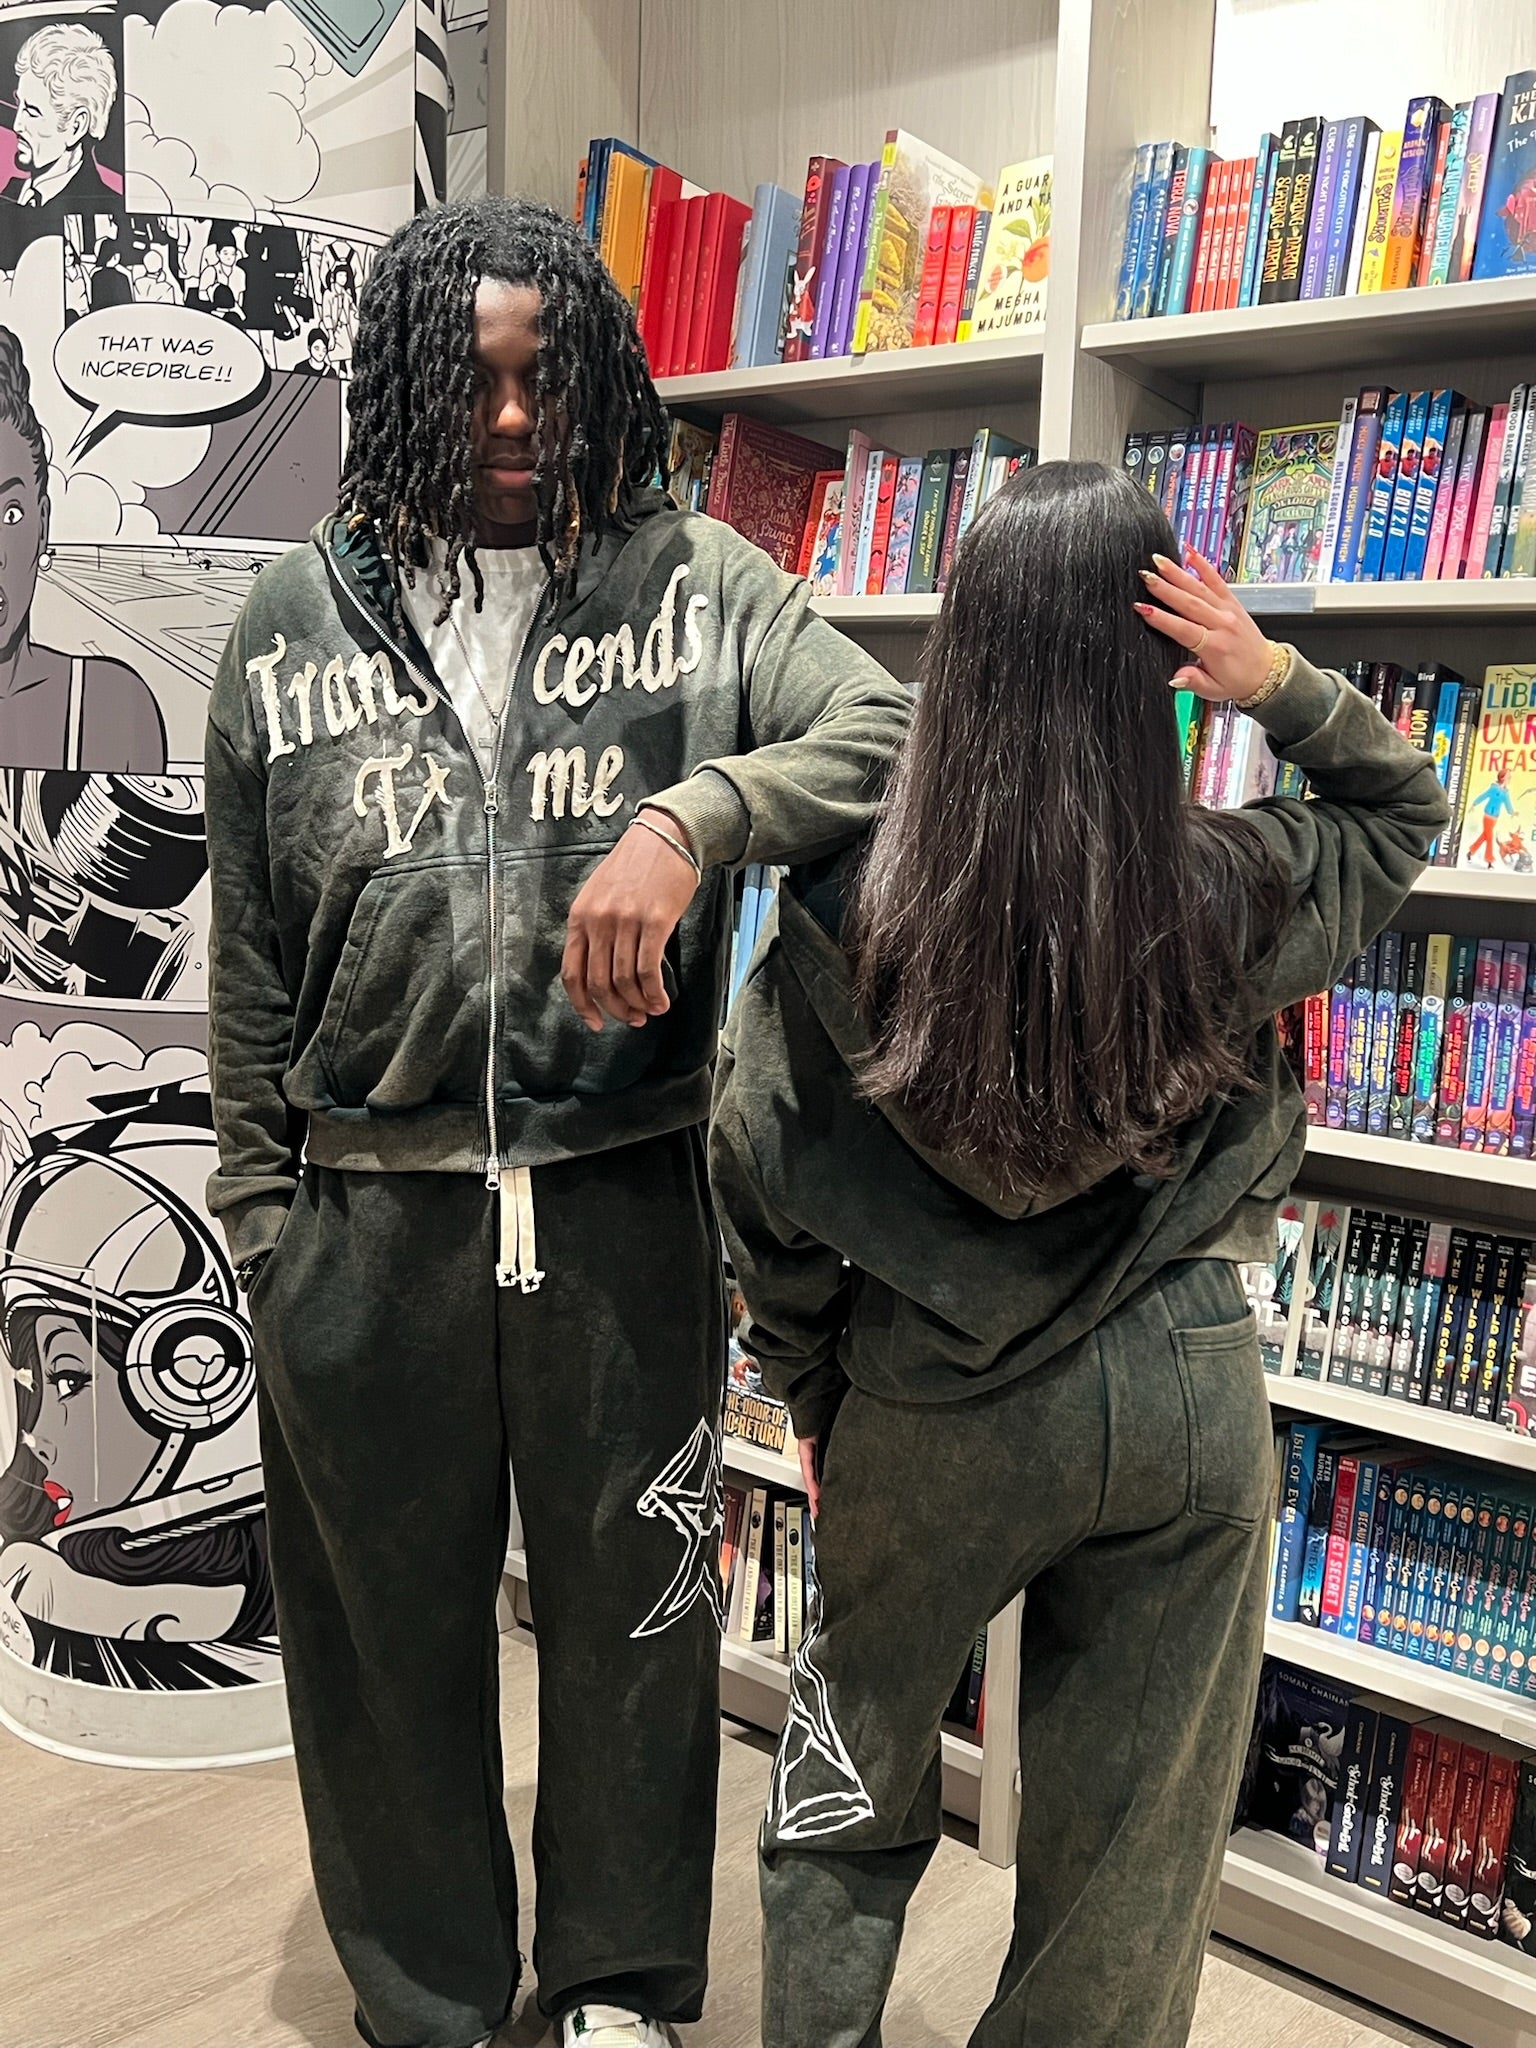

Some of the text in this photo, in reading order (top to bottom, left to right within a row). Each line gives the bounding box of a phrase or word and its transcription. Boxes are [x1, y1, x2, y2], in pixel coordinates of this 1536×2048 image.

[1506, 136, 1528, 153] The
[1002, 184, 1009, 197] A
[1314, 126, 1337, 233] CURSE NIGHT WITCH
[1334, 124, 1357, 234] CURSE FORGOTTEN CITY
[998, 196, 1034, 216] AND A
[1166, 169, 1188, 238] TERRA NOVA
[1263, 176, 1292, 282] SCARING DARING
[1282, 174, 1312, 280] SCARING DARING
[1307, 256, 1316, 276] ALEX
[1324, 255, 1336, 297] ALEX ASTER
[994, 291, 1040, 311] MEGHA
[99, 336, 214, 356] THAT WAS
[81, 361, 232, 382] INCREDIBLE!!
[1508, 391, 1522, 431] LINWOOD
[1501, 432, 1515, 468] BARCLAY
[1332, 461, 1344, 490] MIDDLE
[768, 508, 792, 528] Little
[1328, 492, 1340, 521] SCHOOL
[1338, 486, 1358, 563] MUSEUM MAYHEM
[1368, 488, 1390, 538] BOY 2.0
[1389, 488, 1412, 538] BOY 2.0
[1410, 486, 1433, 536] BOY 2.0
[1490, 506, 1504, 536] CHASE
[1507, 505, 1520, 536] CHASE
[759, 521, 796, 546] Prince
[1418, 672, 1436, 682] Bird
[1496, 673, 1514, 686] THE
[1459, 712, 1468, 734] SECOND
[1514, 708, 1528, 719] OF
[1456, 734, 1465, 758] CHANCE
[526, 744, 625, 822] me
[1448, 765, 1460, 805] BENJAMIN
[1439, 829, 1453, 856] FALLS
[1337, 1230, 1362, 1356] THE WILD ROBOT
[1356, 1234, 1382, 1362] THE WILD ROBOT
[1374, 1238, 1400, 1366] THE WILD ROBOT
[1397, 1241, 1422, 1370] THE WILD ROBOT
[1435, 1249, 1463, 1380] THE WILD ROBOT
[1459, 1253, 1487, 1384] THE WILD ROBOT
[1482, 1258, 1510, 1392] THE WILD ROBOT
[1414, 1326, 1428, 1379] PROTECTS
[738, 1414, 786, 1450] RETURN
[743, 1397, 786, 1427] DOOR OF
[1284, 1432, 1305, 1524] ISLE OF EVER
[1316, 1452, 1326, 1482] BURNS
[1324, 1454, 1333, 1482] PETER
[1326, 1504, 1350, 1607] PERFECT SECRET
[1347, 1510, 1369, 1618] BECAUSE TERUPT
[1278, 1671, 1308, 1690] SOMAN
[1341, 1764, 1359, 1831] School Good
[1374, 1775, 1391, 1843] School Good
